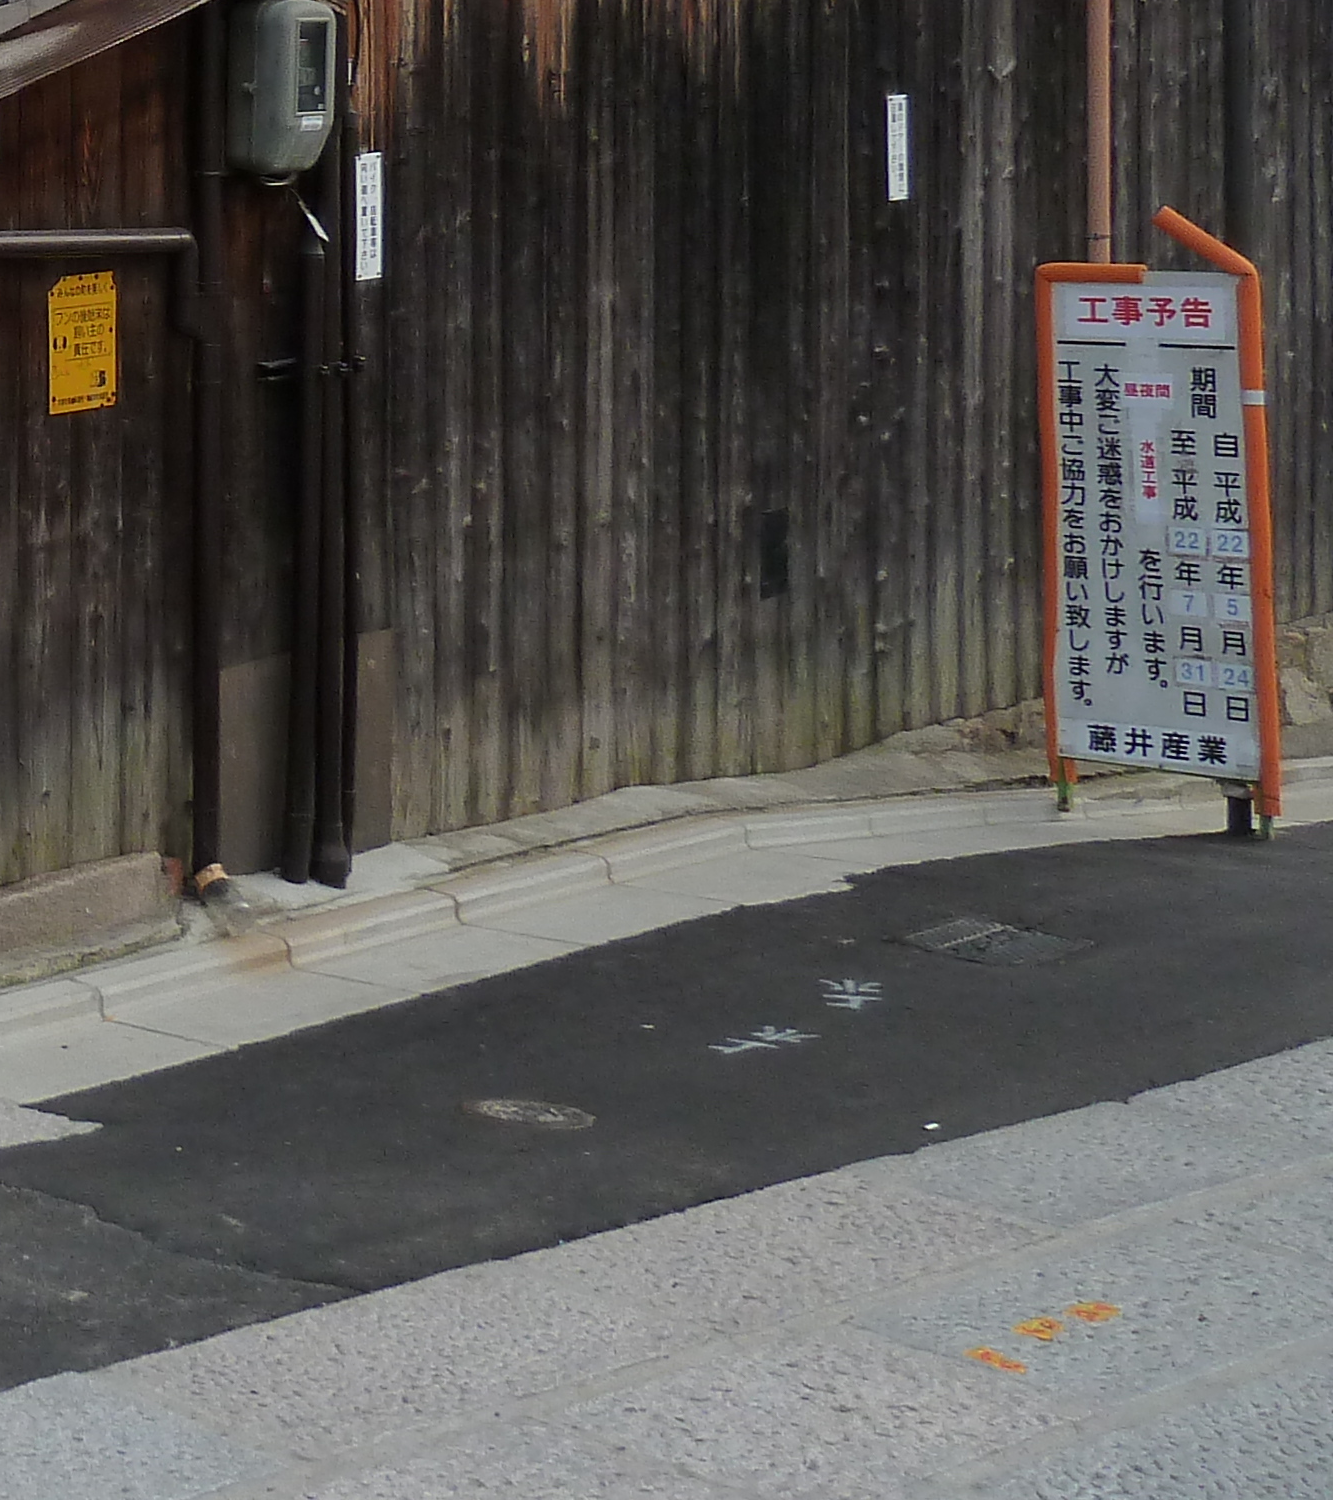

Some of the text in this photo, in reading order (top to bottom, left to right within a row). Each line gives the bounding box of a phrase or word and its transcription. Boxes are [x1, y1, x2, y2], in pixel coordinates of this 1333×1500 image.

[1077, 296, 1213, 329] 工事予告
[1123, 382, 1172, 399] 昼夜間
[1190, 366, 1217, 419] 期間
[1139, 438, 1158, 500] 水道工事
[1057, 360, 1093, 707] 工事中ご協力をお願い致します。
[1093, 363, 1130, 675] 大変ご迷惑をおかけしますが
[1137, 548, 1169, 689] を行います。
[1086, 723, 1228, 766] 藤井産業
